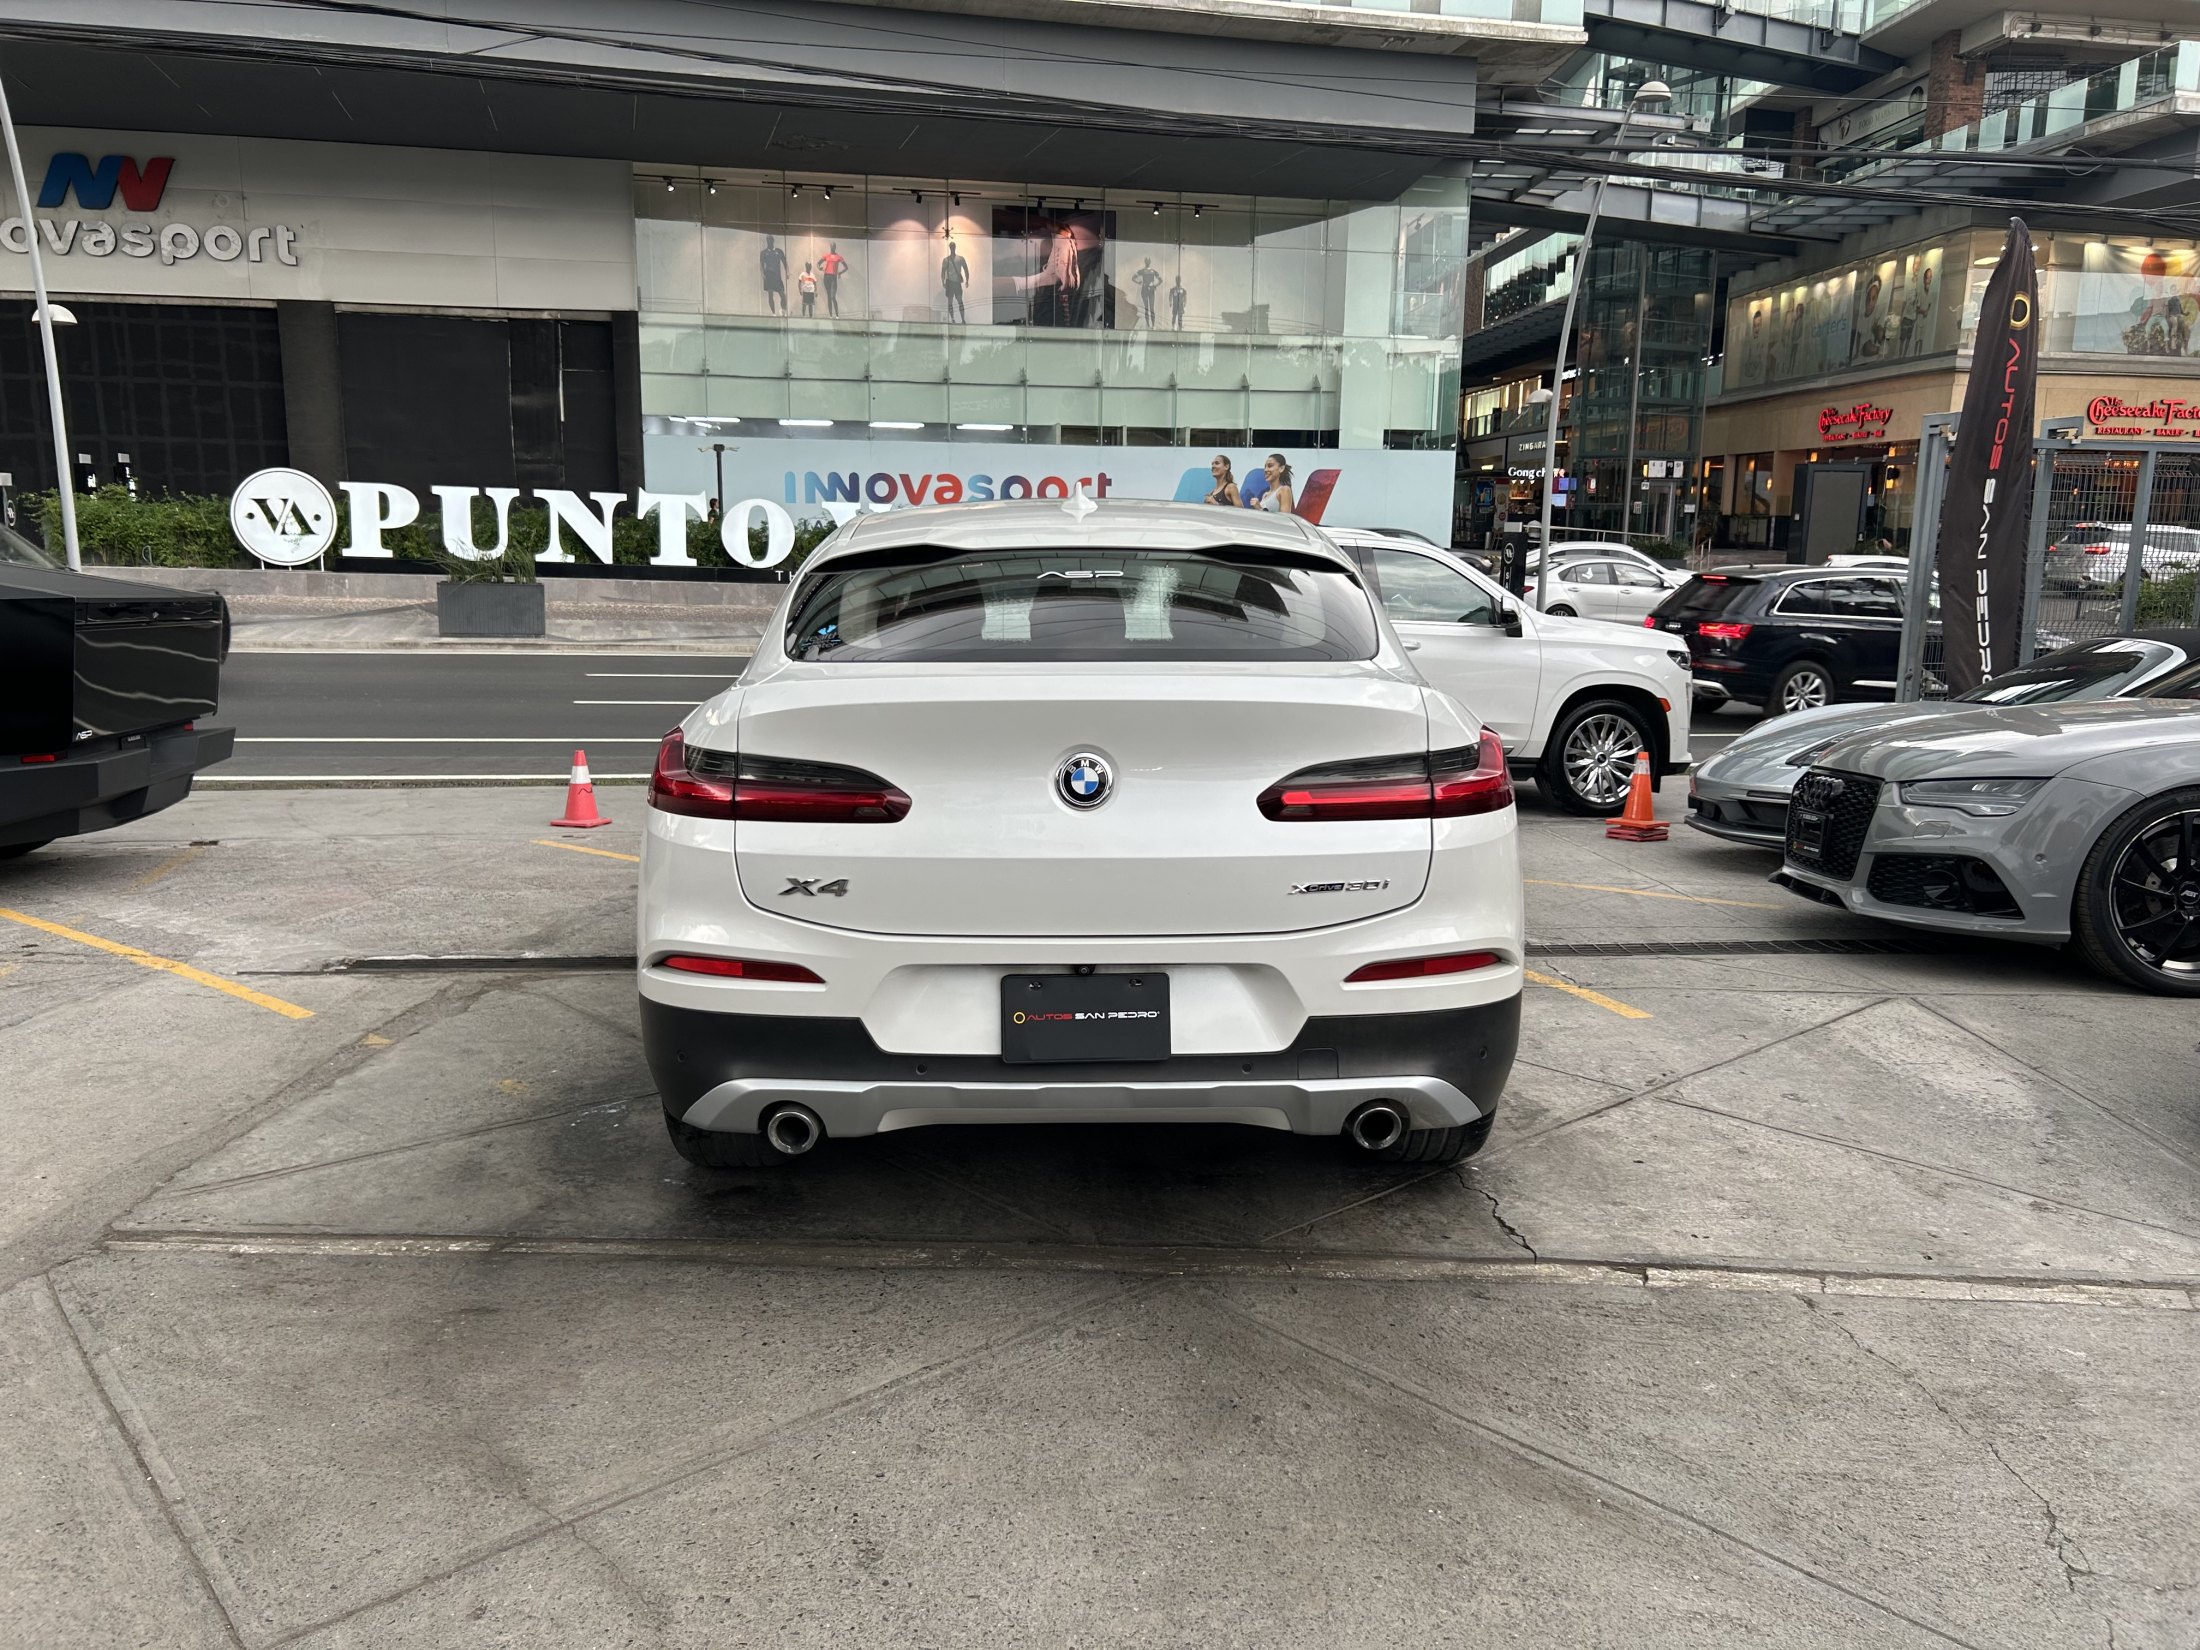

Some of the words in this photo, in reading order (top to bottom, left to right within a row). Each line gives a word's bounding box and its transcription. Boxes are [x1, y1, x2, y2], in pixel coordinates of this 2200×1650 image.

[1989, 338, 2020, 470] AUTOS
[2087, 396, 2165, 425] Cheesecake
[2161, 399, 2200, 426] Fact
[2096, 426, 2144, 436] RESTAURANT
[1519, 441, 1546, 451] ZINGARA
[1508, 467, 1535, 479] Gong
[337, 481, 796, 568] PUNTO
[1978, 478, 1996, 559] SAN
[1066, 759, 1105, 775] BMW
[778, 878, 849, 897] X4
[1026, 1013, 1073, 1021] AUTOS
[1075, 1012, 1106, 1020] SAN
